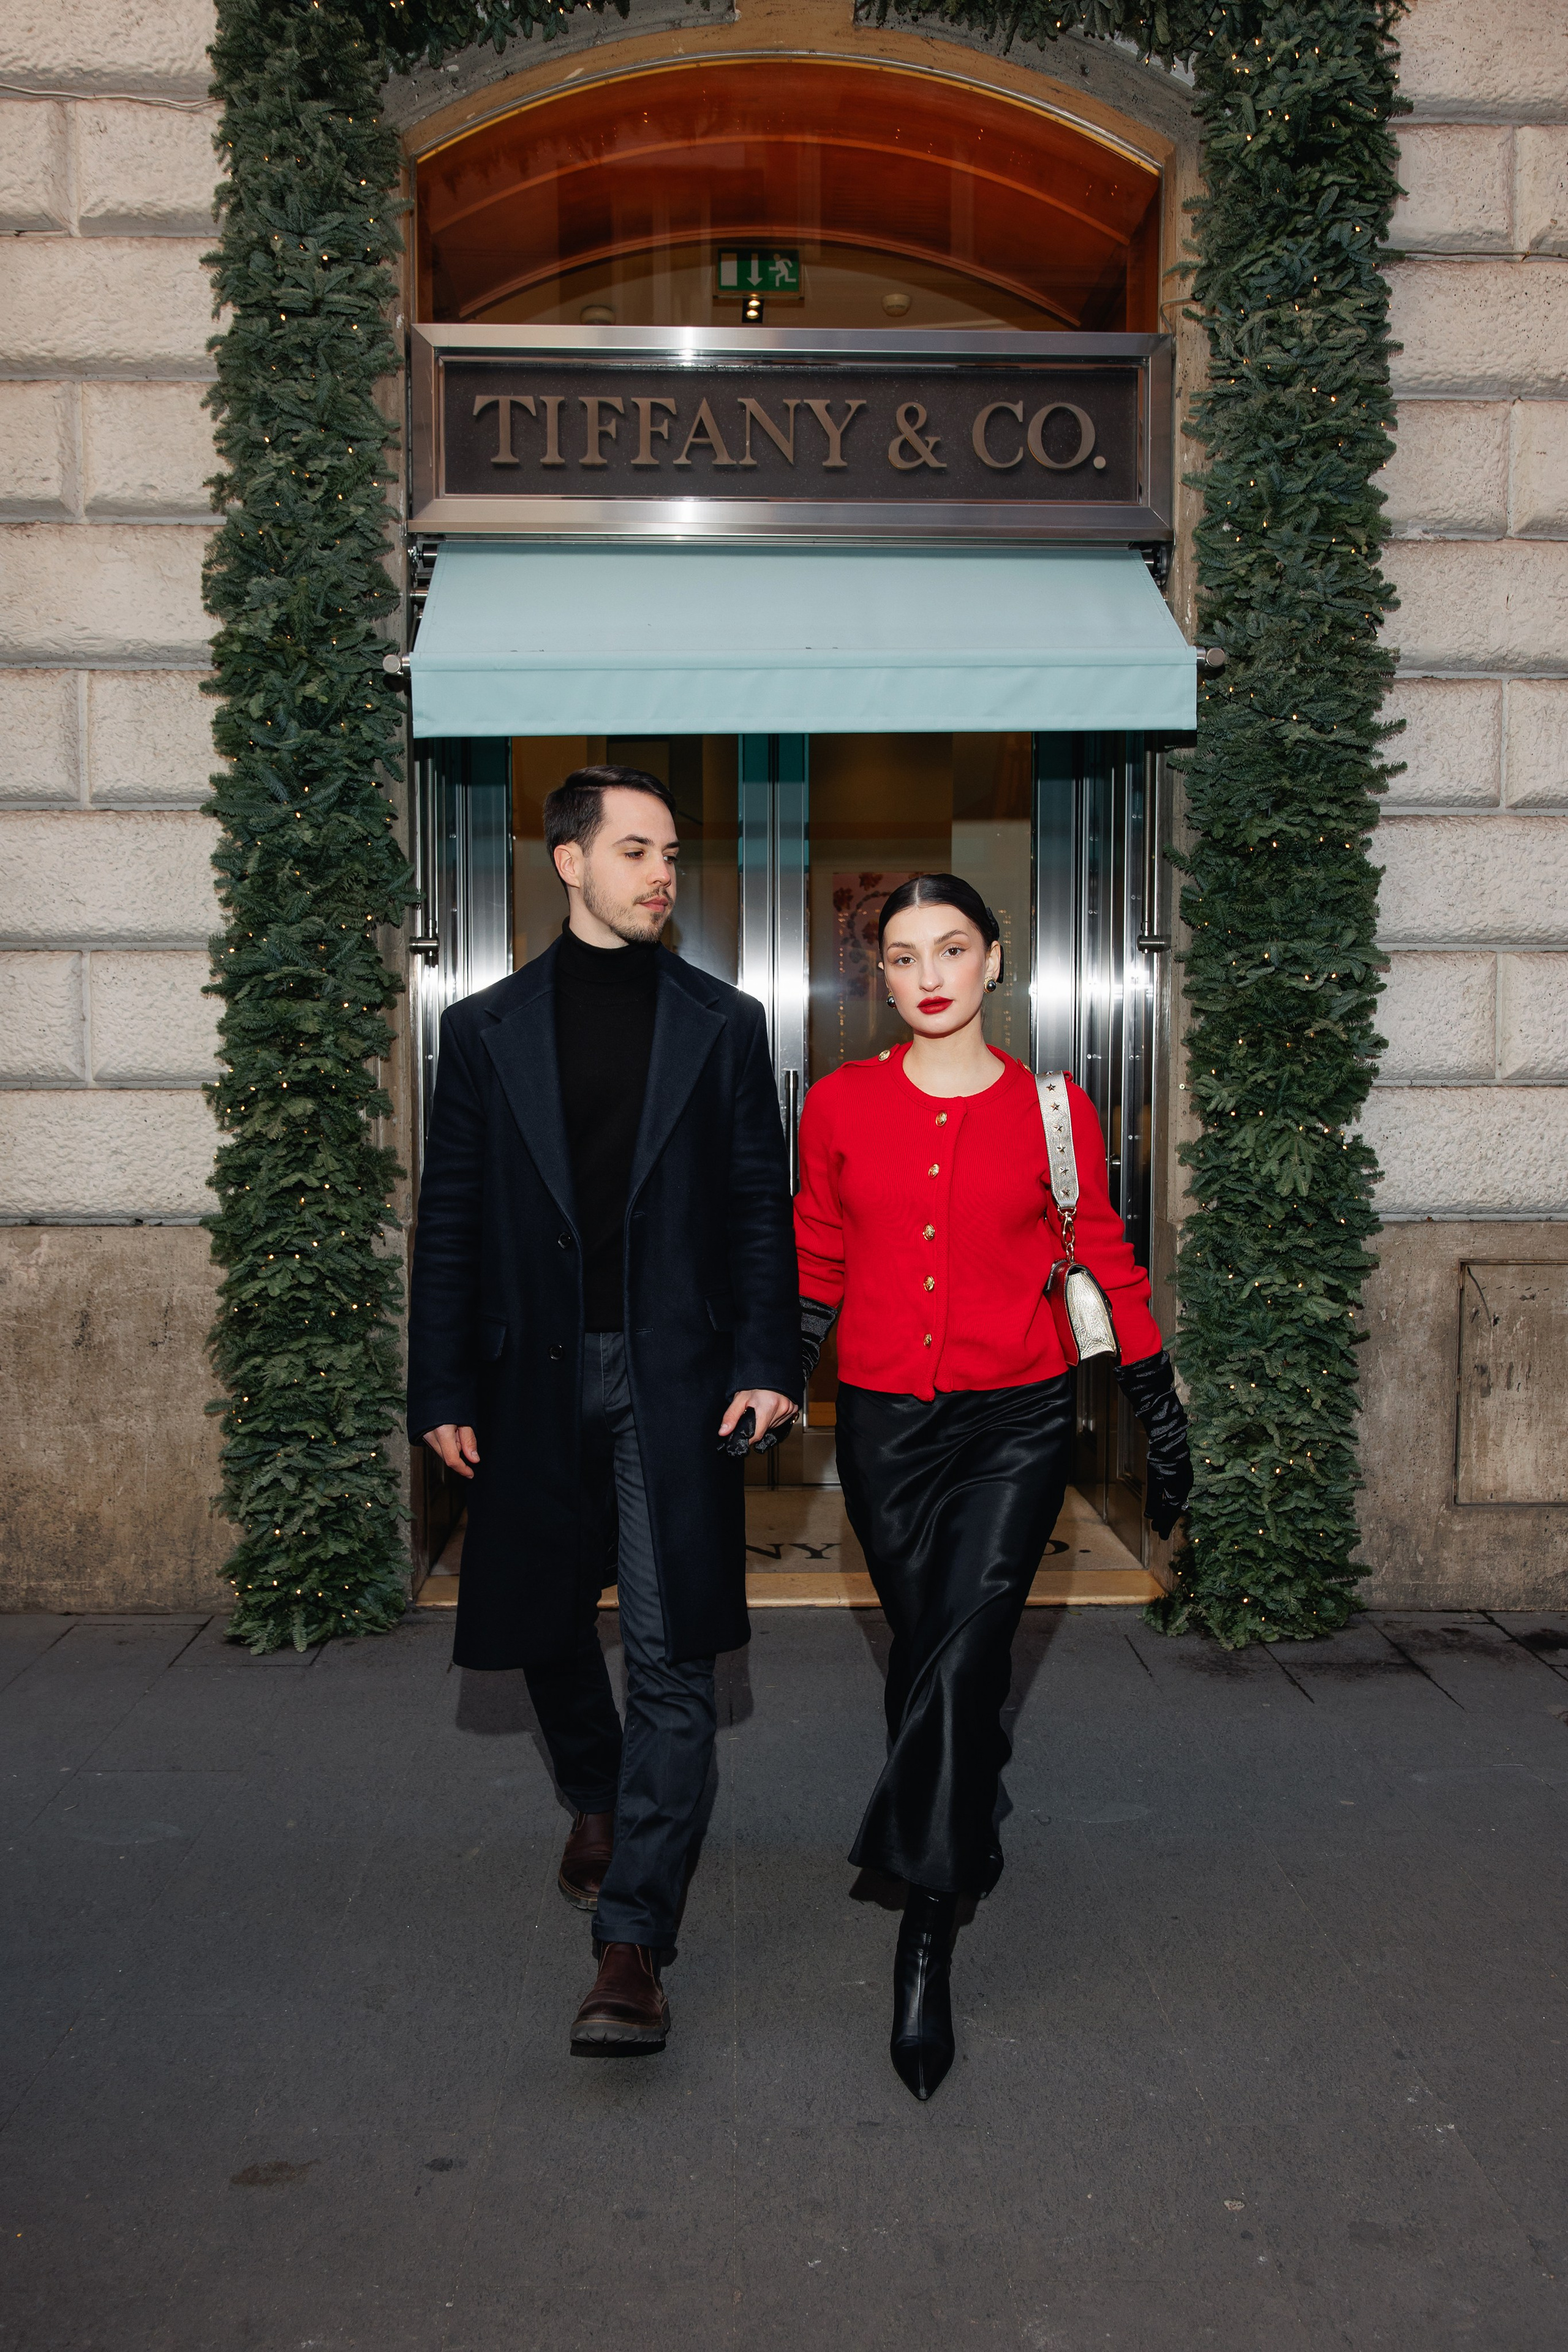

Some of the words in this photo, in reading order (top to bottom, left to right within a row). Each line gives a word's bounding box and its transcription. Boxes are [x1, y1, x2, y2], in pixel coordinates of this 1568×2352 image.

[472, 395, 867, 467] TIFFANY
[888, 401, 948, 470] &
[972, 400, 1106, 470] CO.
